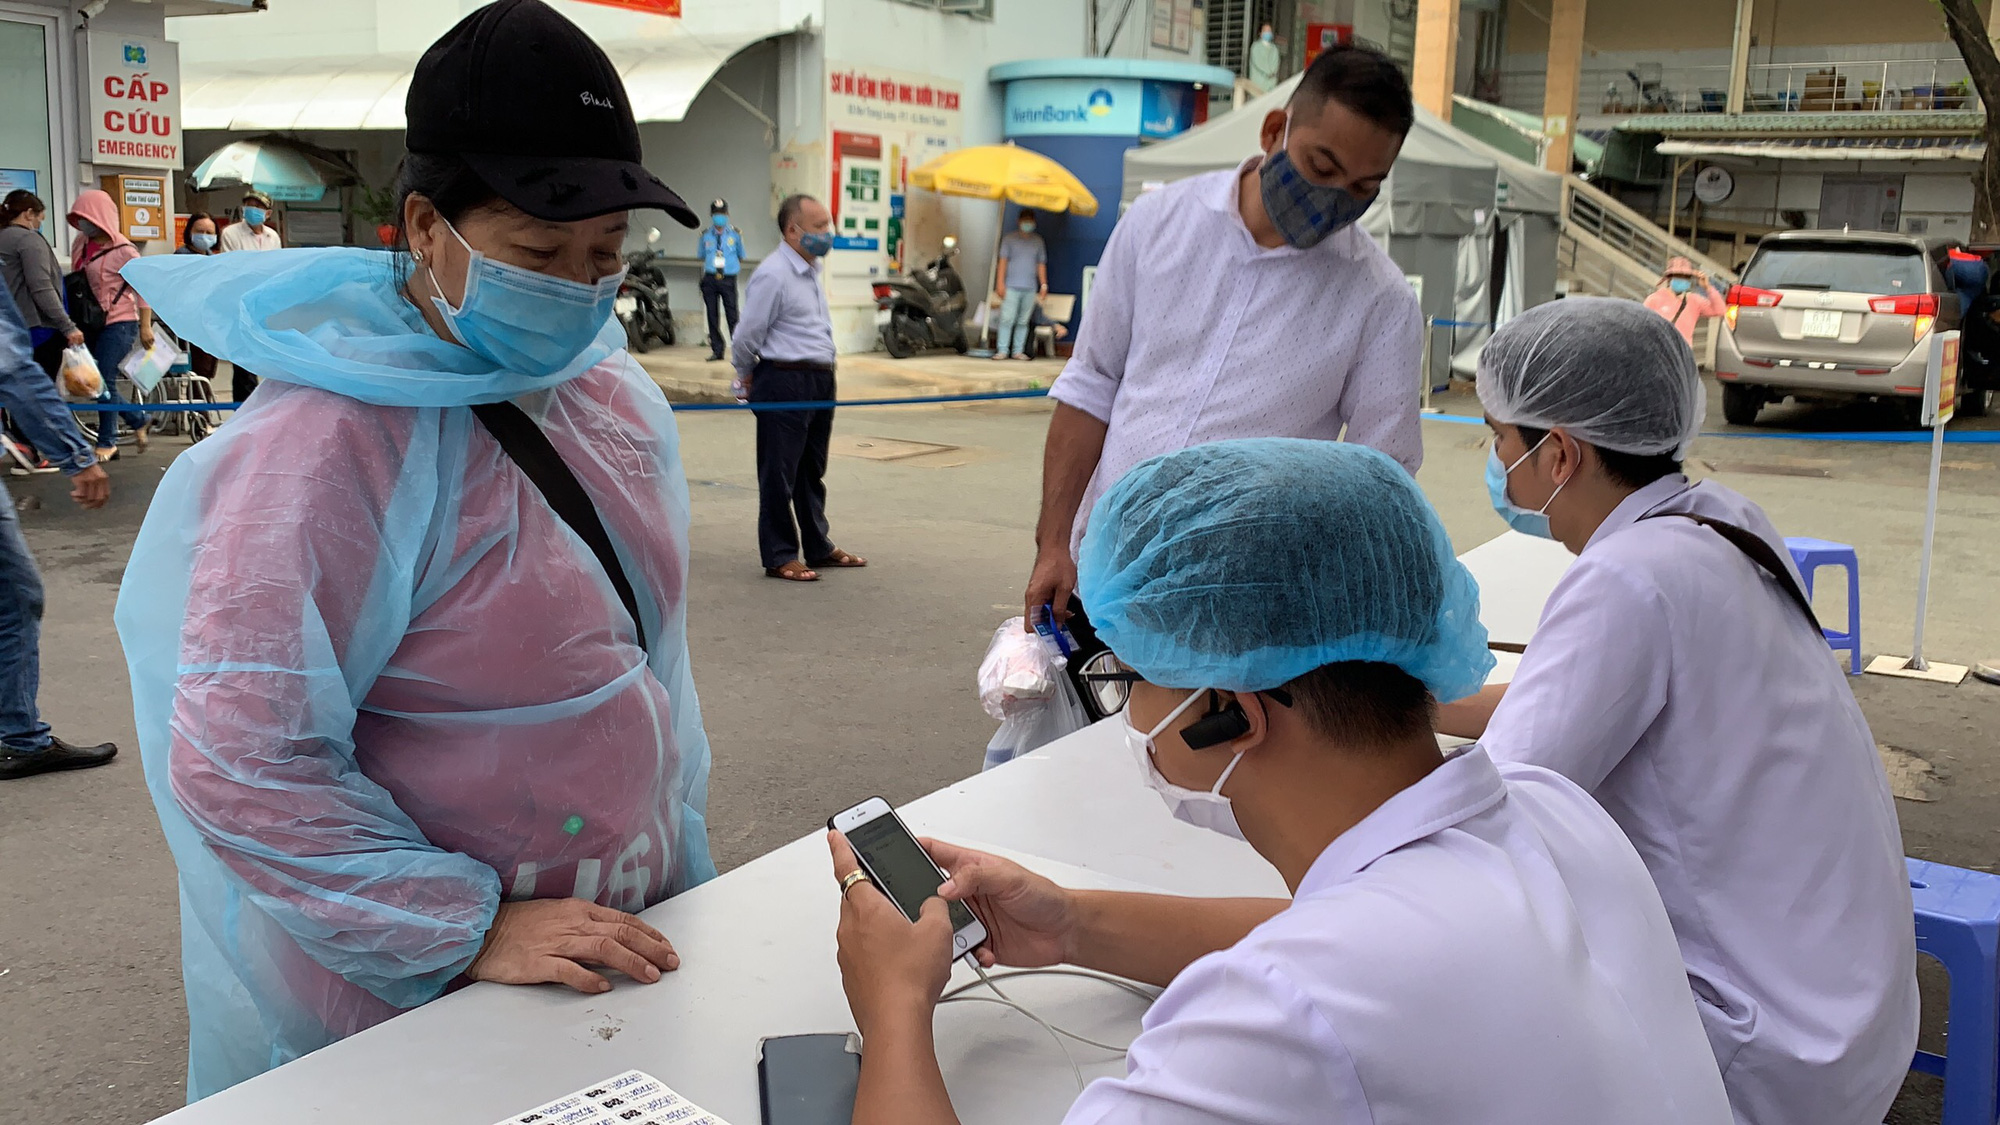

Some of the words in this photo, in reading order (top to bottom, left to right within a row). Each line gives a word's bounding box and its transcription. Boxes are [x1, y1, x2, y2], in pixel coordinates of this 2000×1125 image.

[104, 72, 169, 102] CẤP
[580, 91, 614, 109] Black
[104, 107, 171, 136] CỨU
[97, 139, 177, 159] EMERGENCY
